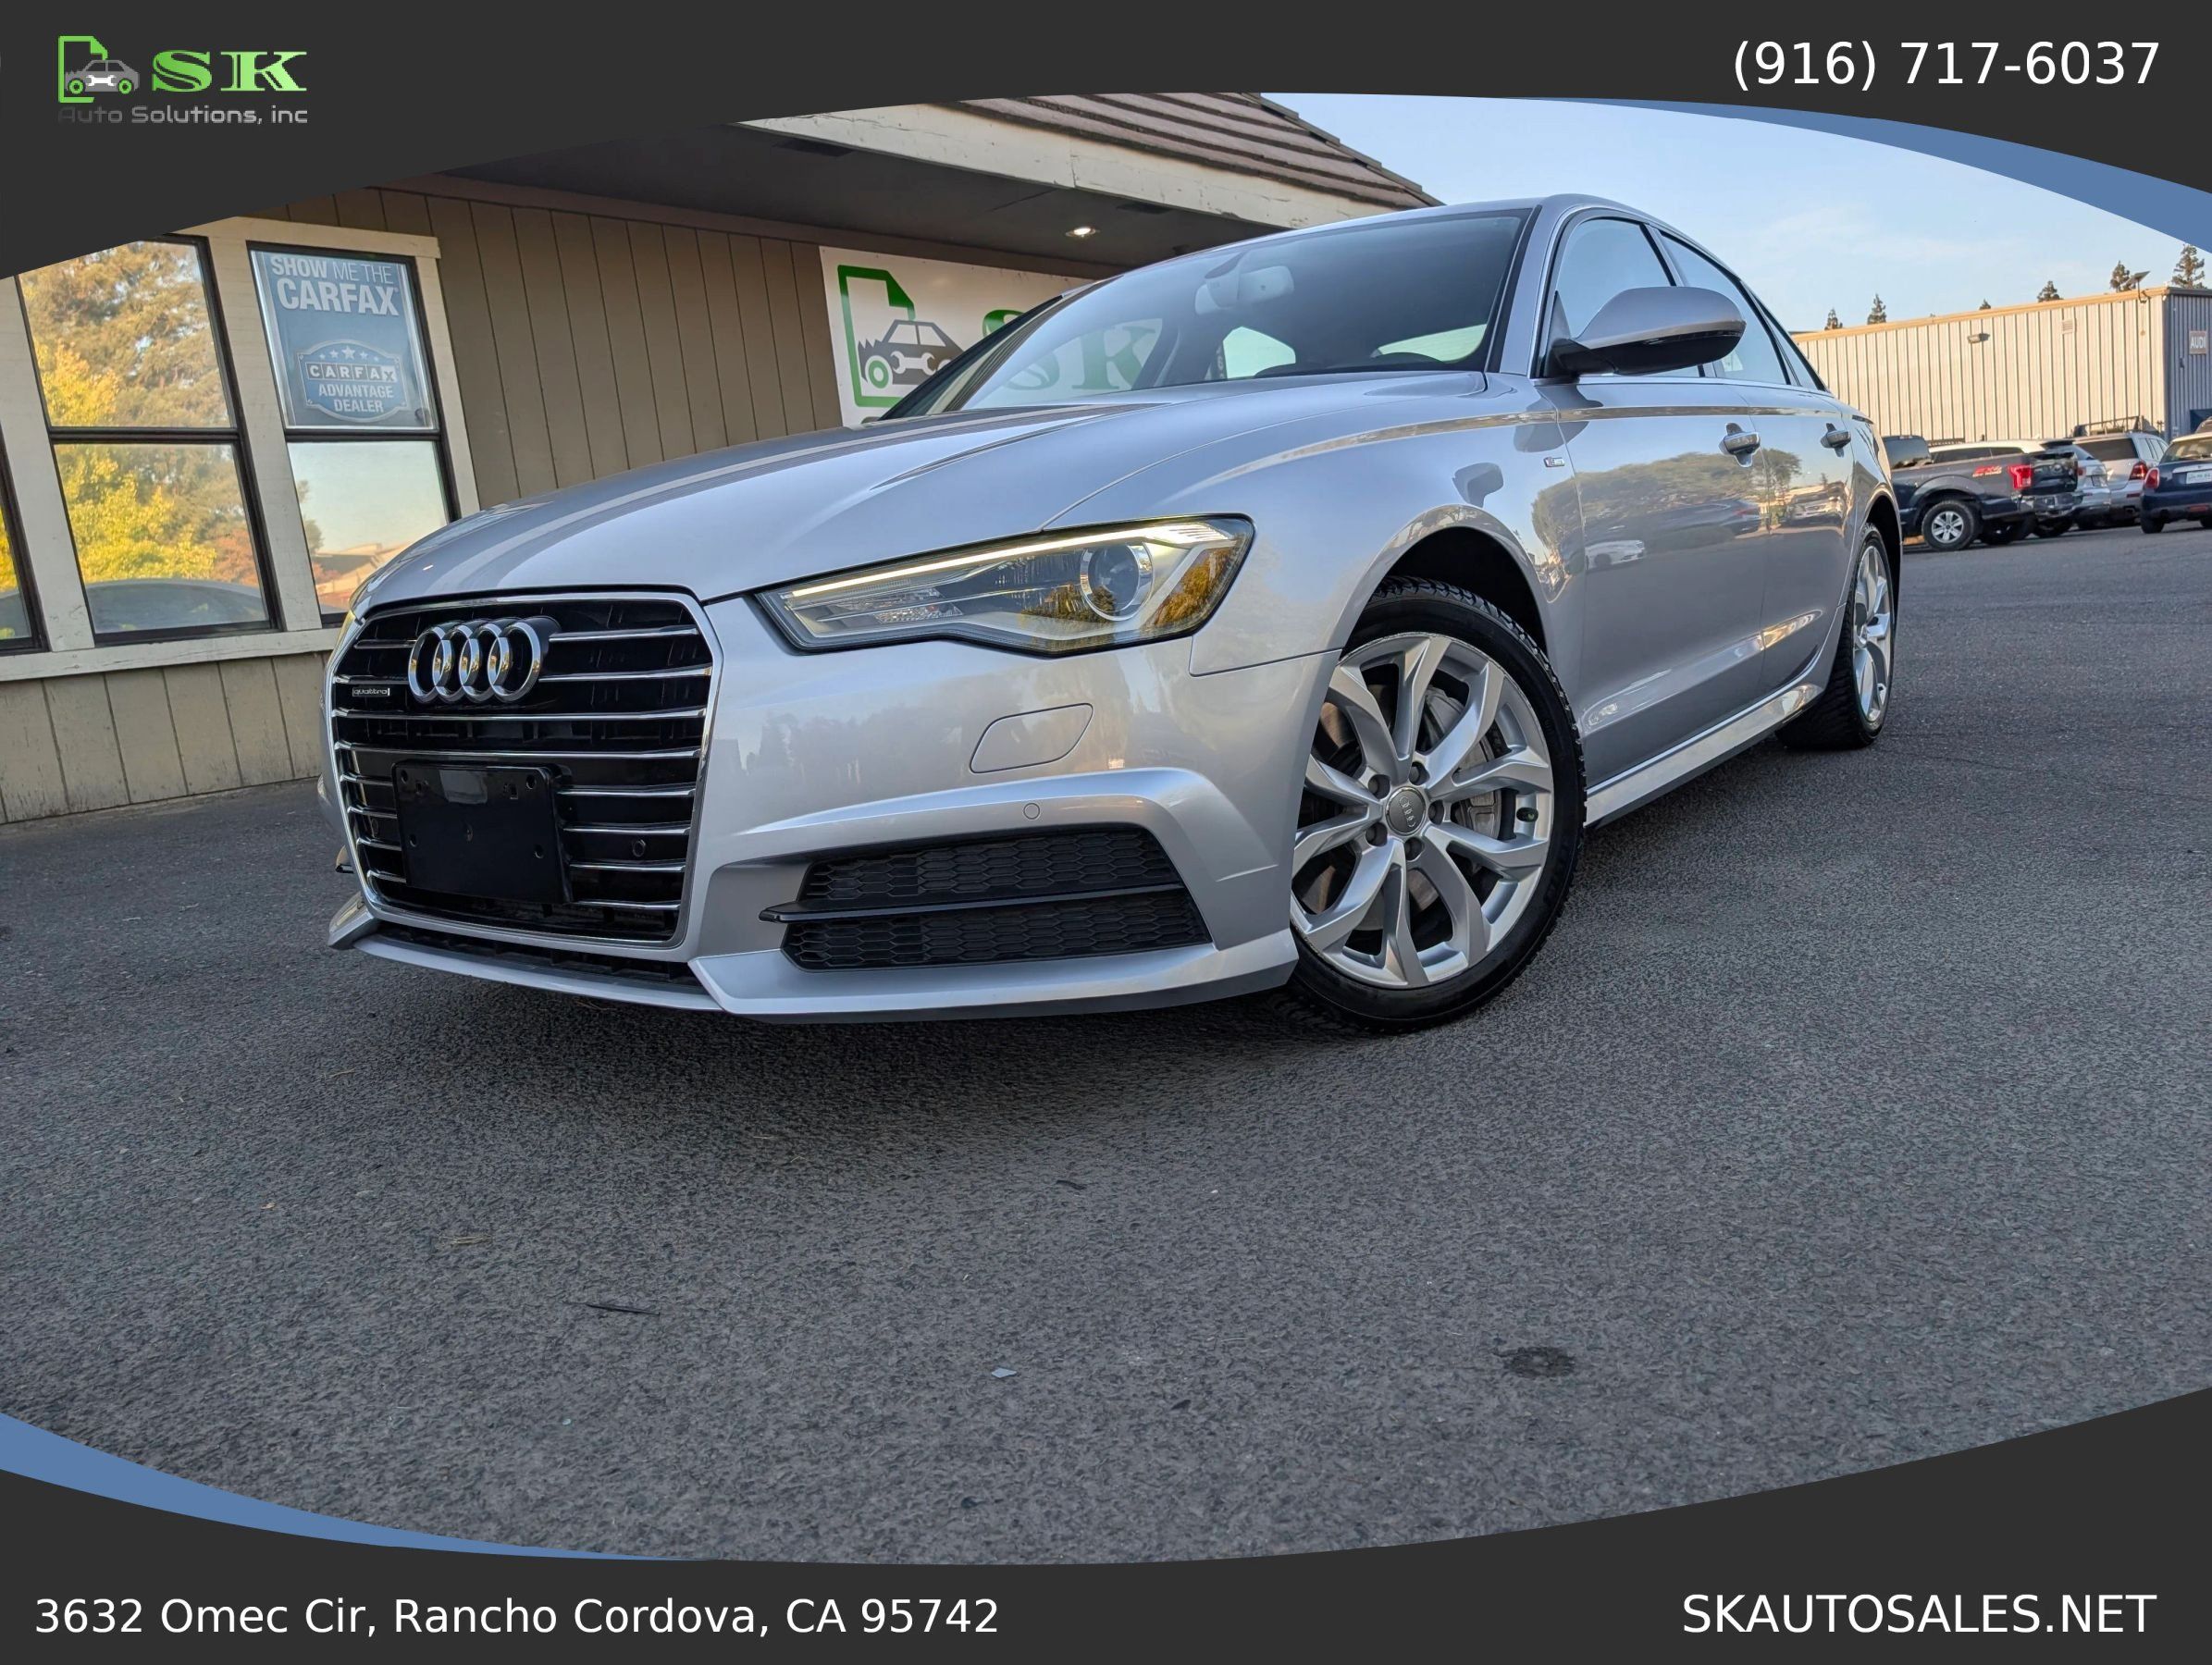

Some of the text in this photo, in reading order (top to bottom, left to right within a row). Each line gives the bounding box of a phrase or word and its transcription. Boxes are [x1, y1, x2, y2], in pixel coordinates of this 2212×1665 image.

[270, 254, 394, 285] SHOW ME THE
[277, 278, 400, 316] CARFAX
[308, 364, 397, 382] CARFAX
[318, 384, 395, 399] ADVANTAGE
[333, 399, 384, 413] DEALER
[353, 687, 388, 696] quattro
